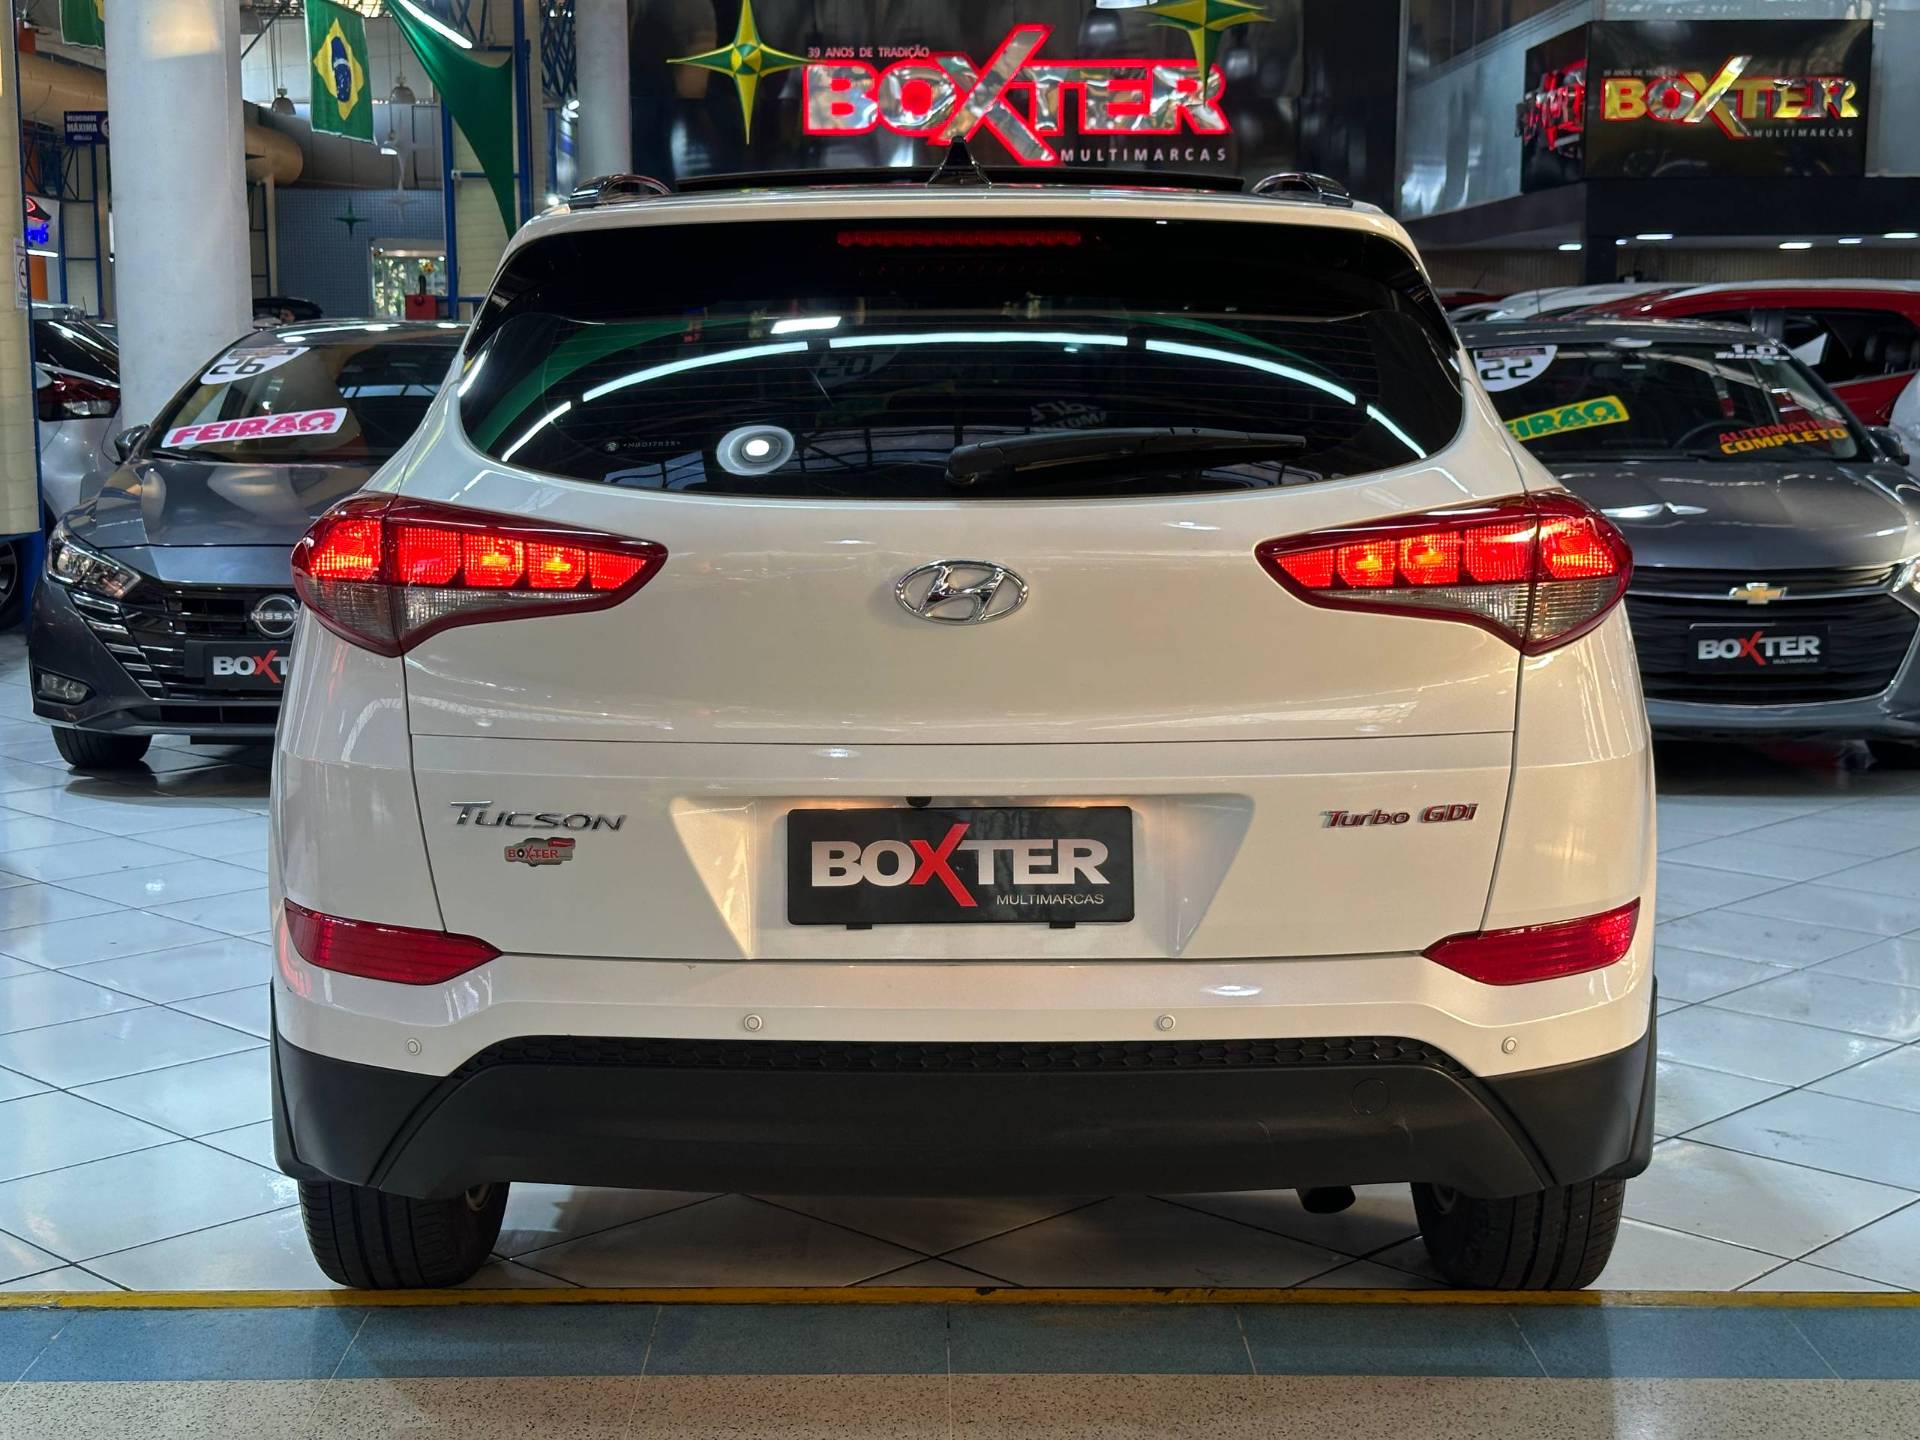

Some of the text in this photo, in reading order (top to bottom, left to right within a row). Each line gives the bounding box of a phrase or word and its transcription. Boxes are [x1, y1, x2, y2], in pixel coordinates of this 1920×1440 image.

[808, 44, 930, 59] 39 ANOS DE TRADIÇÃO
[803, 24, 1231, 166] BOXTER
[1602, 55, 1859, 140] BOXTER
[1754, 127, 1853, 138] MULTIMARCAS
[1060, 148, 1227, 162] MULTIMARCAS
[1721, 428, 1849, 454] COMPLETO
[1698, 630, 1820, 666] BOXTER
[213, 649, 289, 684] BOXT
[450, 800, 627, 832] TUCSON
[1320, 809, 1410, 828] Turbo
[508, 845, 559, 862] BOXTER
[810, 823, 1111, 907] BOXTER
[996, 893, 1104, 905] MULTIMARCAS
